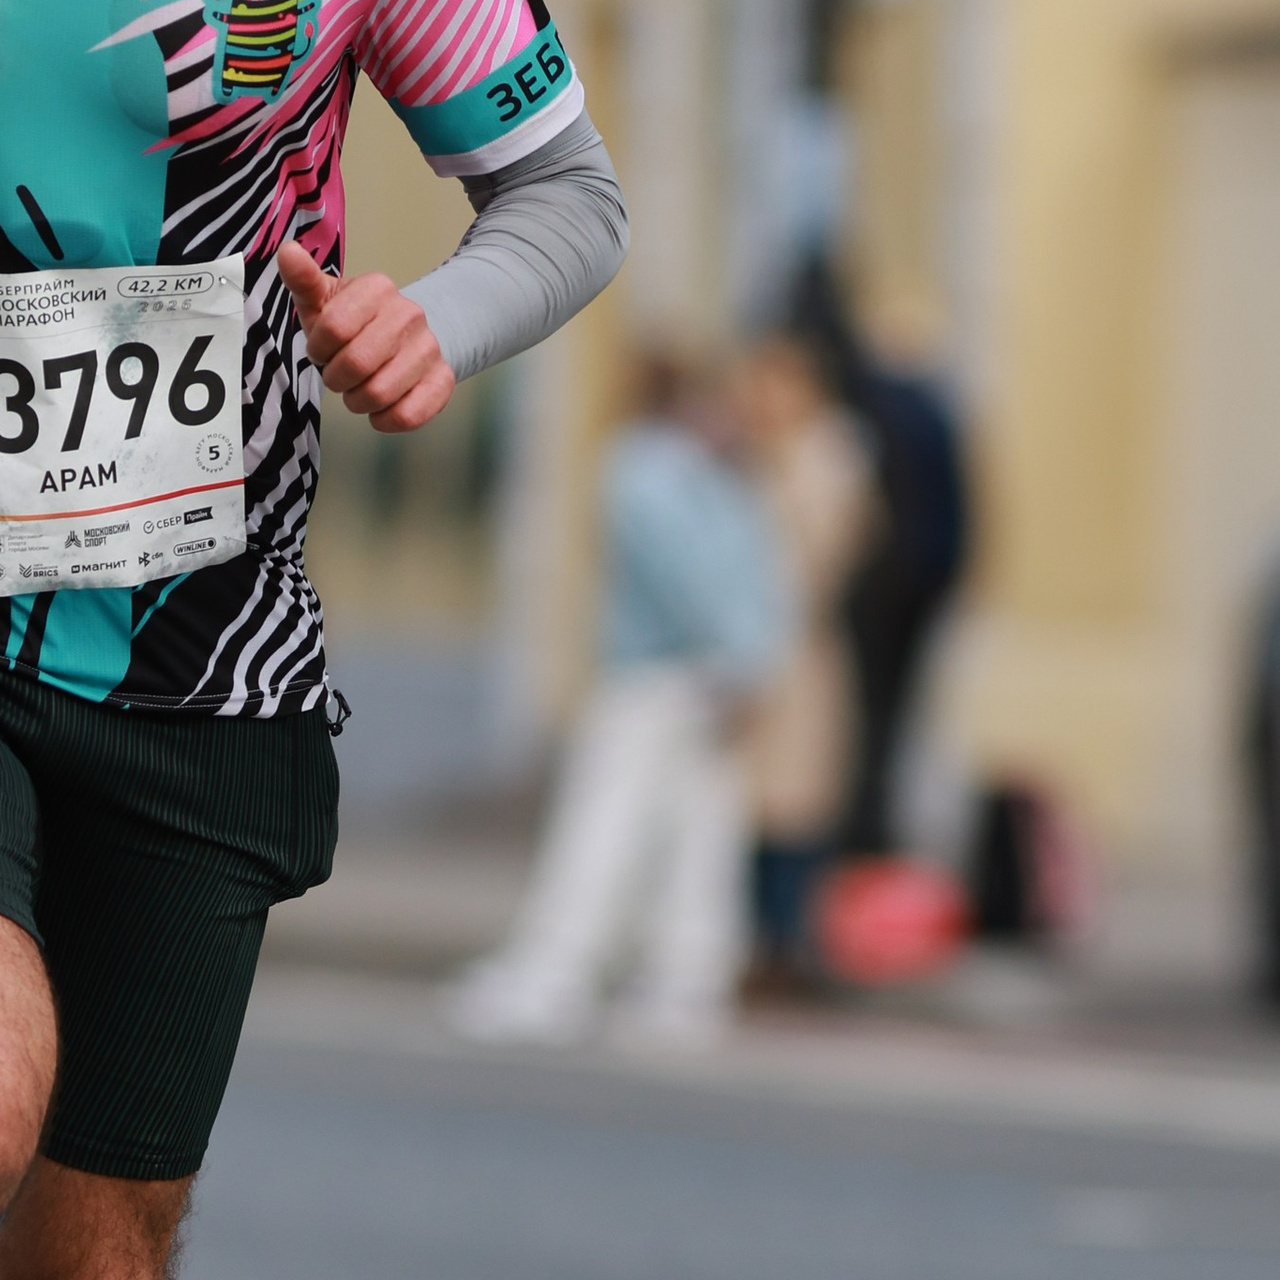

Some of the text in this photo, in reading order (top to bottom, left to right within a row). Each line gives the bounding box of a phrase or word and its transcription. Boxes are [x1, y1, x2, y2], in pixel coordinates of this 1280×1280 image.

[486, 29, 566, 122] ЗЕБ
[128, 279, 168, 294] 42,2
[209, 444, 220, 461] 5
[39, 460, 118, 494] АРАМ
[84, 520, 131, 538] МОСКОВСКИЙ
[156, 516, 182, 529] СБЕР
[84, 536, 107, 548] СПОРТ
[177, 541, 207, 553] WINLINE
[33, 569, 59, 578] BRICS
